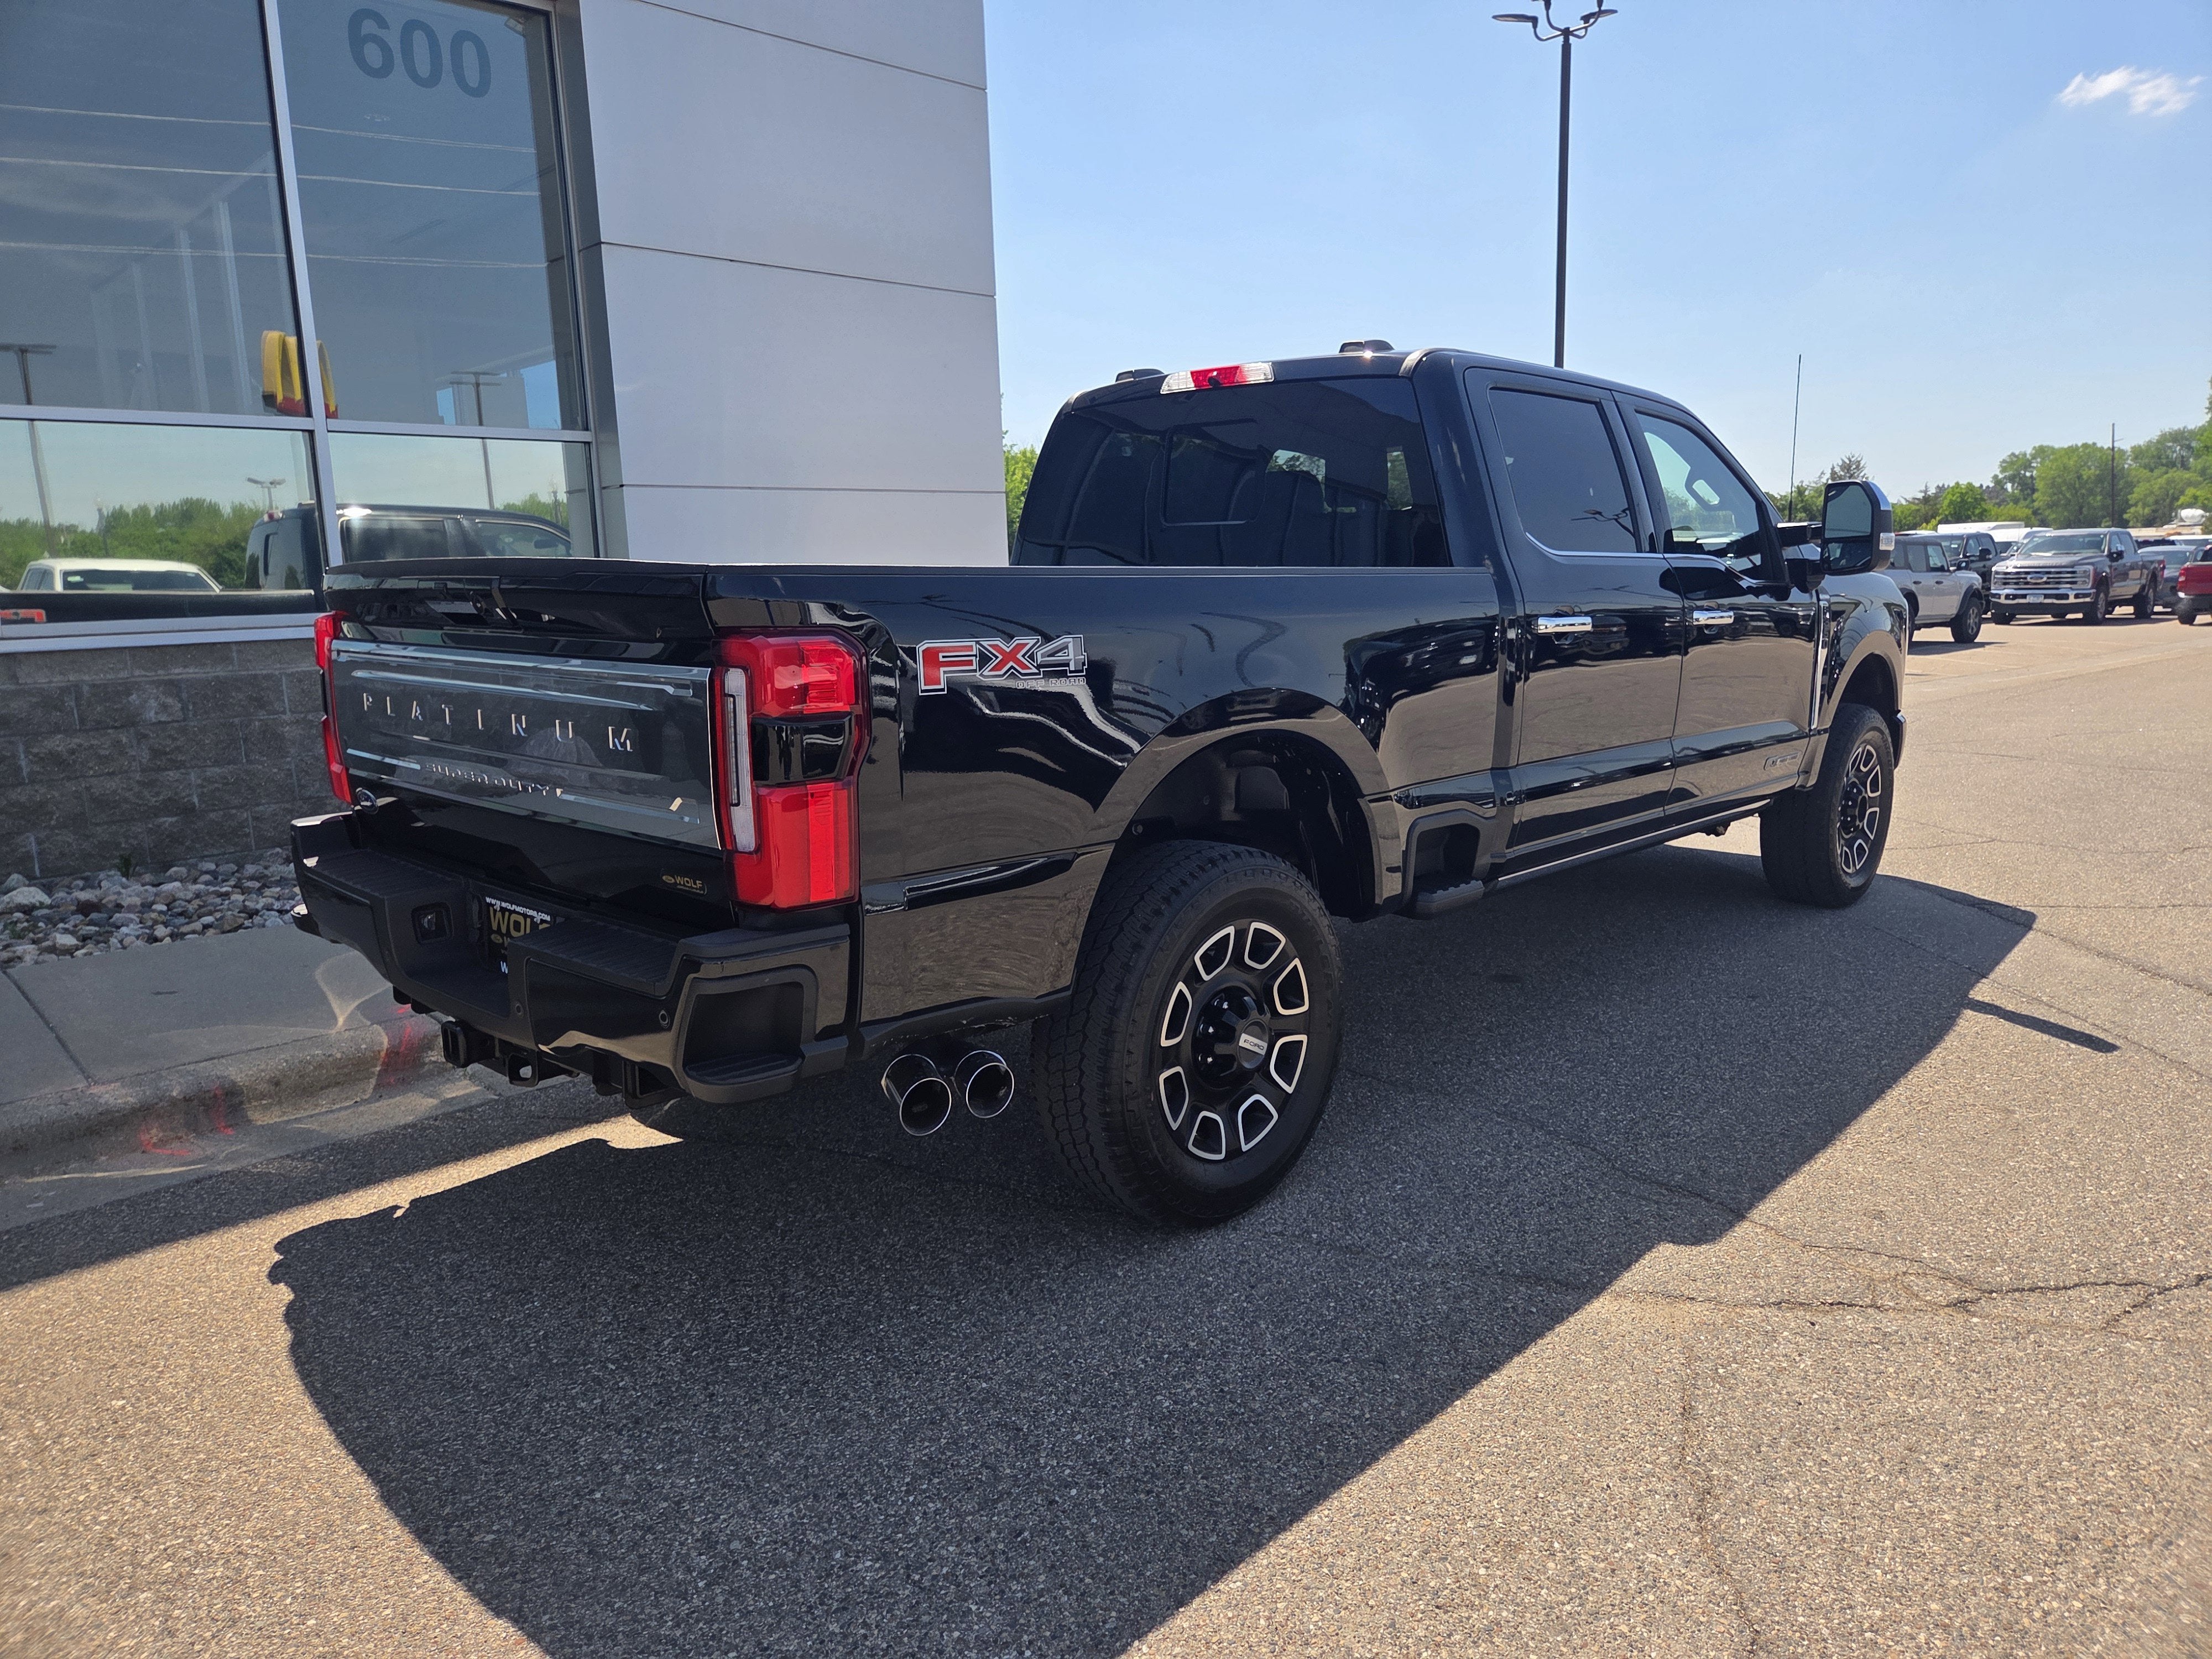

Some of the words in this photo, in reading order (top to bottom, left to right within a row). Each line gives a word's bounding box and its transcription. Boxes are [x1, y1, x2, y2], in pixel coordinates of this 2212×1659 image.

[348, 8, 492, 98] 600
[916, 635, 1087, 696] FX4
[1016, 680, 1045, 689] OFF
[1049, 677, 1086, 687] ROAD
[363, 692, 633, 752] PLATINUM
[494, 777, 551, 796] DUTY
[675, 875, 703, 889] WOLF
[1244, 1039, 1264, 1050] FORD
